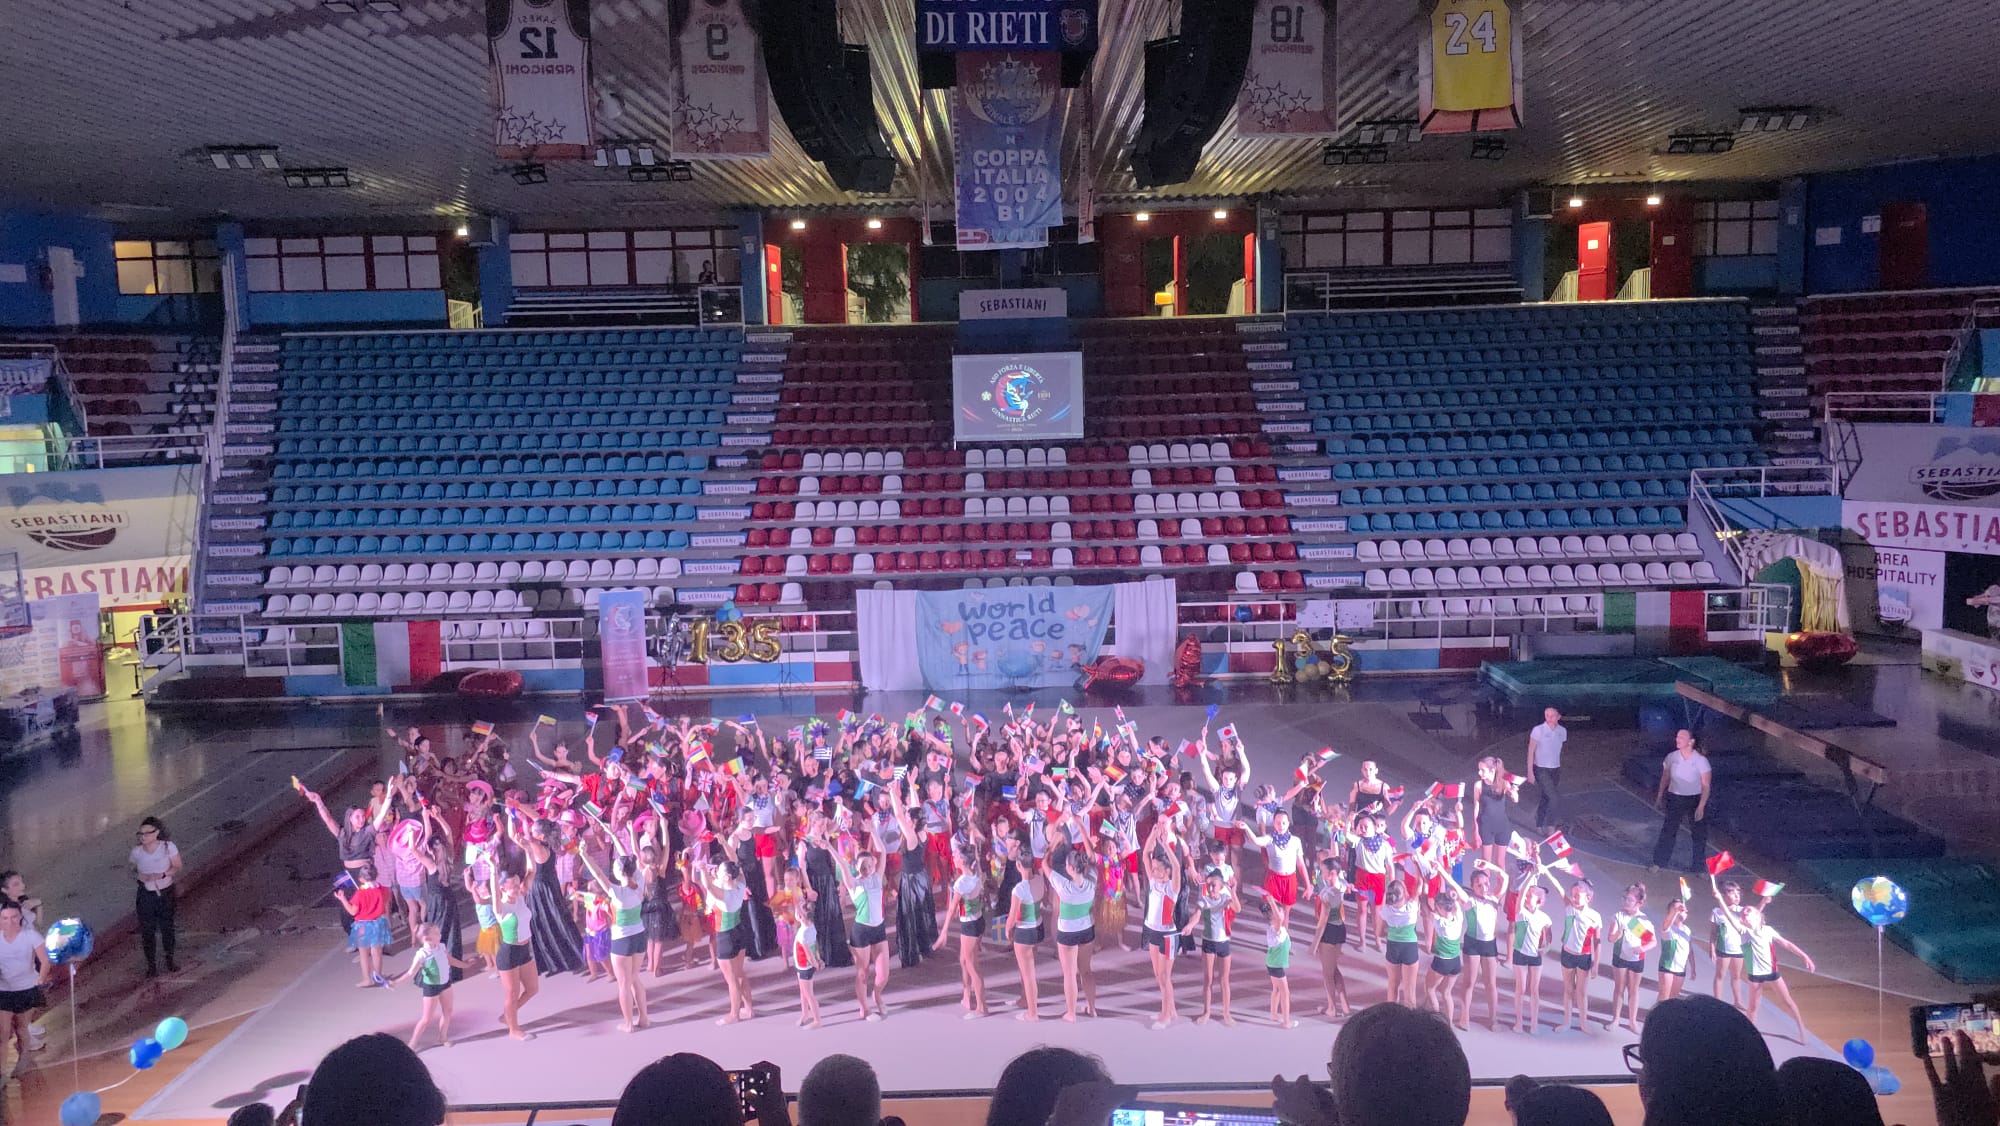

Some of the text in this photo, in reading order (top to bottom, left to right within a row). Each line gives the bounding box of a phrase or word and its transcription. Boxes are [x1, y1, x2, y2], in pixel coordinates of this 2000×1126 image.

[924, 11, 1049, 45] DI RIETI
[1444, 10, 1497, 56] 24
[972, 149, 1049, 167] COPPA
[974, 168, 1048, 185] ITALIA
[998, 206, 1025, 222] B1
[980, 297, 1047, 313] SEBASTIANI
[10, 513, 124, 529] SEBASTIANI
[1857, 511, 2000, 545] SEBASTIA
[1874, 552, 1909, 567] AREA
[1847, 566, 1937, 586] HOSPITALITY
[958, 591, 1056, 621] world
[687, 616, 782, 664] 135
[967, 618, 1065, 646] peace
